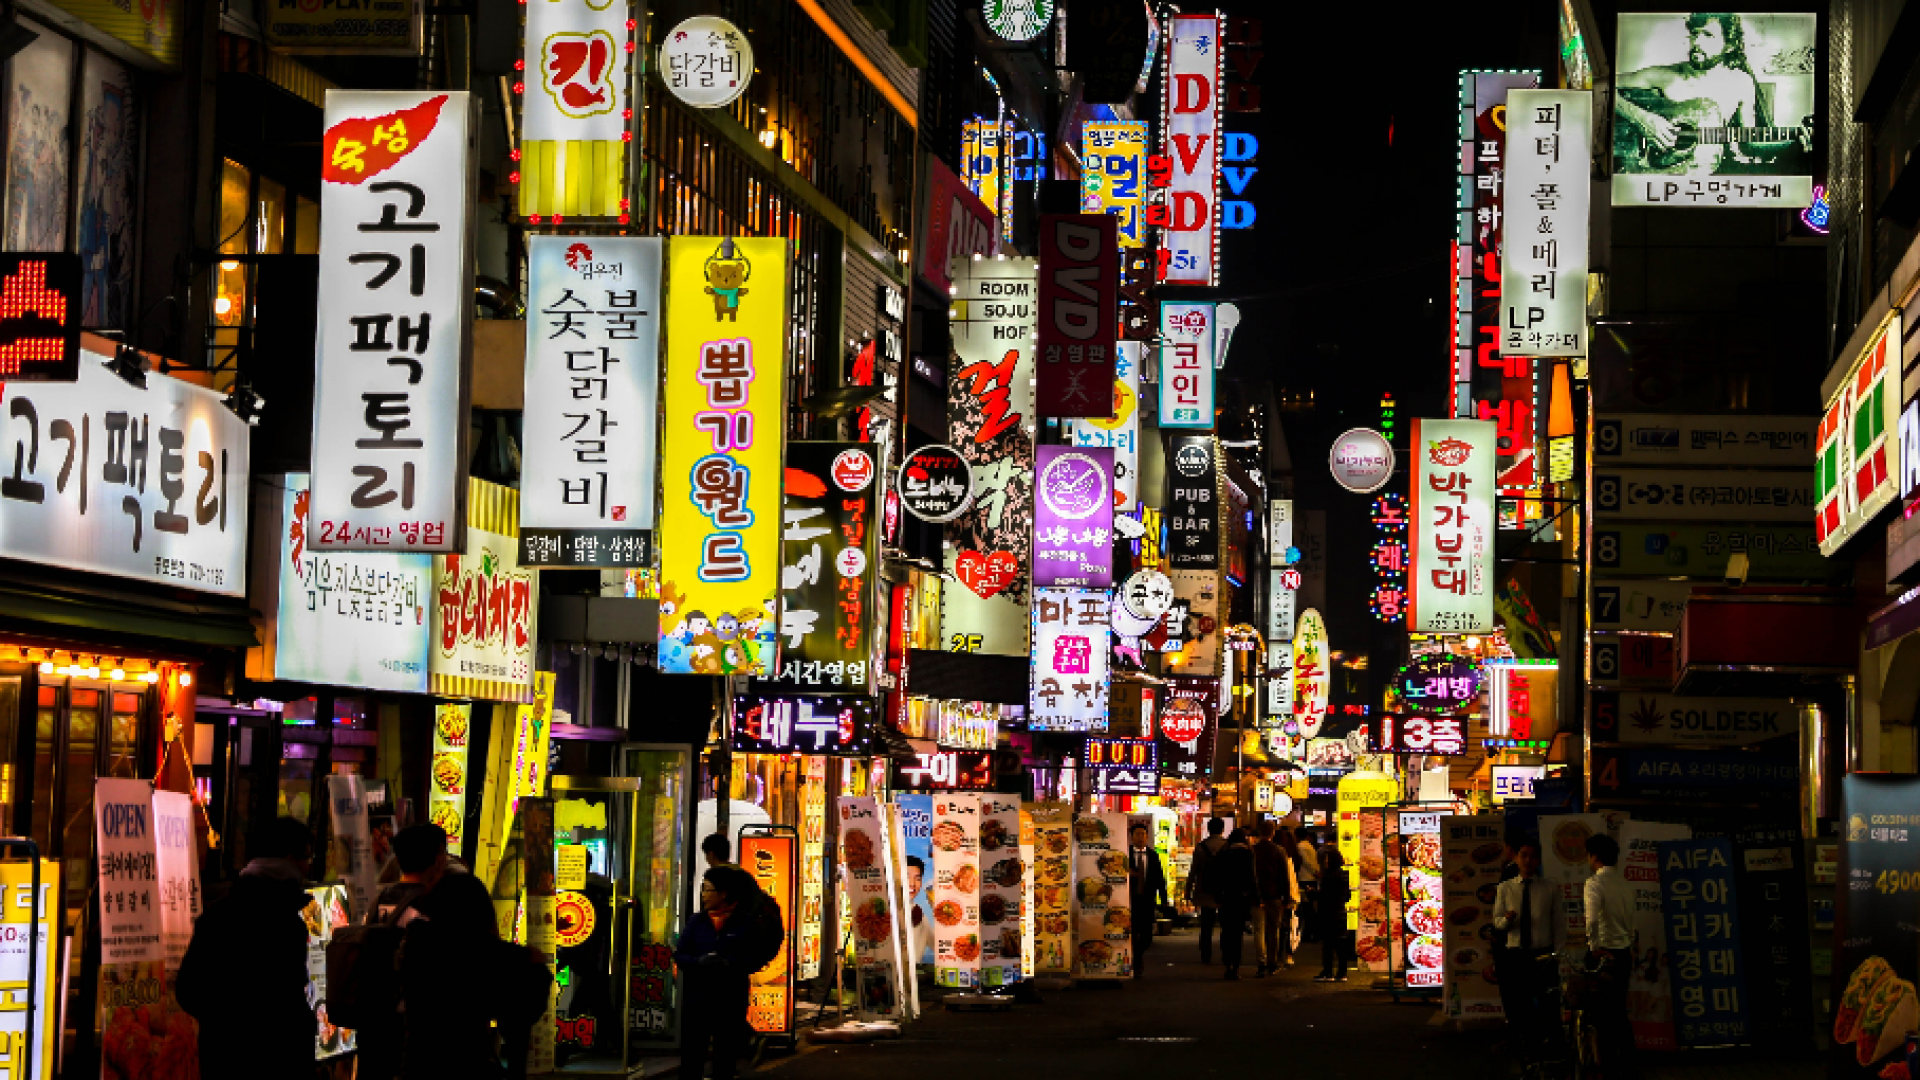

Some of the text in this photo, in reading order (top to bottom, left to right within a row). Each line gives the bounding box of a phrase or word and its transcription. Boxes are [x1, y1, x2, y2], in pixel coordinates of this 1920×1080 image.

[549, 38, 607, 108] 킨
[669, 50, 741, 88] 닭갈비
[1172, 73, 1210, 232] DVD
[1221, 132, 1259, 230] DVD
[1646, 180, 1782, 204] LP 구멍가게
[980, 284, 1029, 296] ROOM
[1055, 221, 1103, 341] DVD
[541, 288, 648, 340] 숯불
[984, 305, 1028, 318] SOJU
[1508, 306, 1545, 329] LP
[348, 181, 441, 511] 고기팩토리
[993, 326, 1028, 339] HOF
[1173, 343, 1200, 405] 코인
[560, 347, 621, 519] 닭갈비
[1600, 425, 1618, 452] 9
[1, 395, 228, 553] 고기팩토리
[692, 336, 760, 583] 뽑기월드
[1175, 489, 1210, 500] PUB
[1598, 480, 1617, 507] 8
[319, 520, 445, 545] 24시간 영업
[1173, 517, 1210, 530] BAR
[1429, 471, 1471, 596] 박가부대
[1376, 500, 1403, 616] 노래방
[1599, 535, 1617, 562] 8
[1039, 597, 1110, 626] 마포
[1598, 593, 1616, 617] 7
[951, 635, 983, 653] 2F
[1596, 648, 1616, 675] 6
[1038, 678, 1104, 708] 곱창
[1406, 677, 1472, 699] 노래방
[1595, 703, 1614, 730] 5
[1670, 710, 1779, 732] SOLDESK
[1404, 717, 1461, 752] 3층
[1599, 757, 1620, 790] 4
[1638, 761, 1684, 776] AIFA
[103, 803, 146, 837] OPEN
[159, 815, 189, 848] OPEN
[1665, 847, 1728, 871] AIFA
[1670, 879, 1706, 1018] 우리경영
[1701, 879, 1739, 1014] 아카데미
